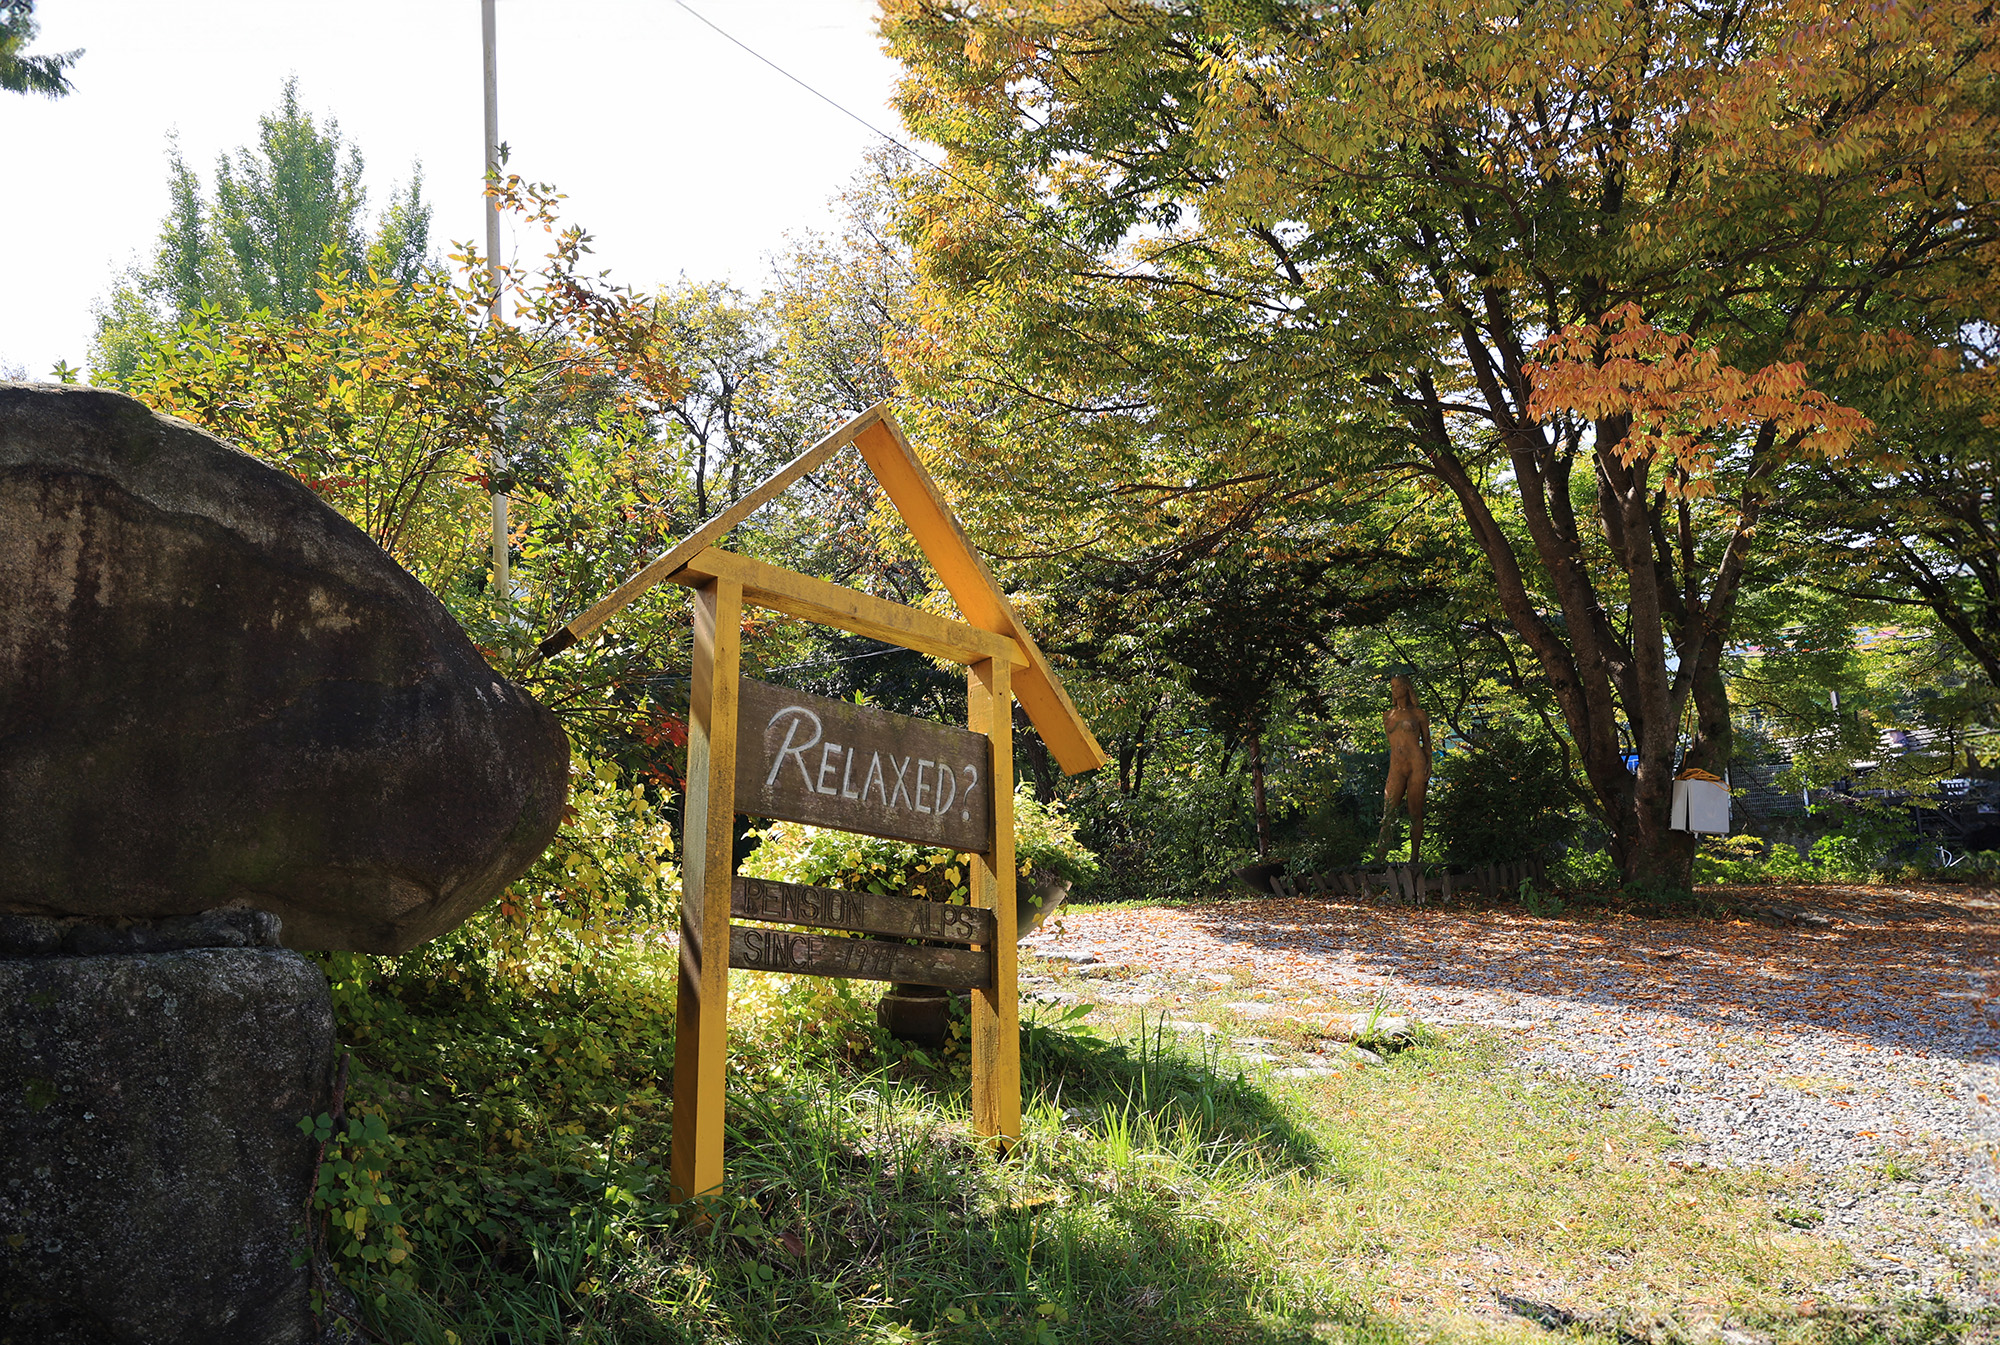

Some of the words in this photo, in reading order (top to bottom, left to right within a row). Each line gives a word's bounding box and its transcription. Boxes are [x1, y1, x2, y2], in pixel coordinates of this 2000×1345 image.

[764, 705, 979, 822] RELAXED?
[742, 880, 865, 928] PENSION
[909, 903, 974, 940] ALPS
[743, 930, 823, 968] SINCE
